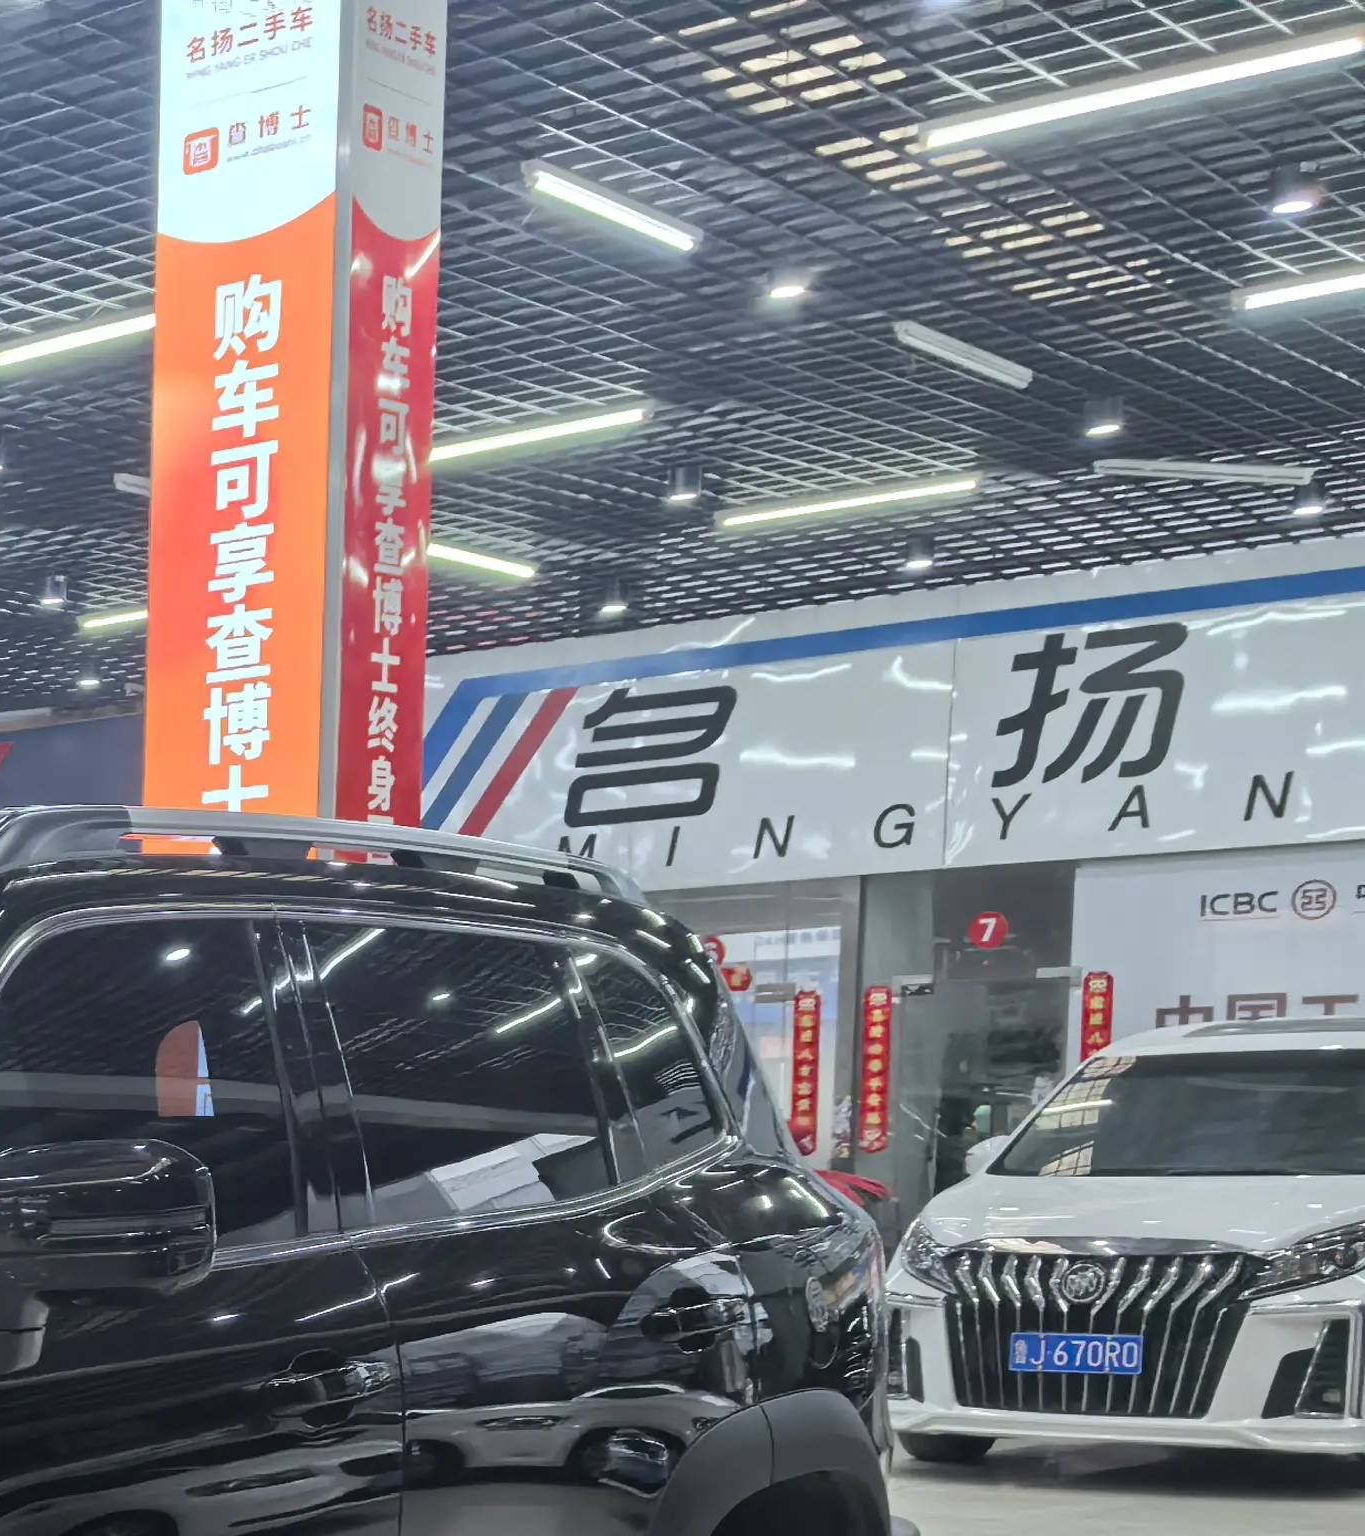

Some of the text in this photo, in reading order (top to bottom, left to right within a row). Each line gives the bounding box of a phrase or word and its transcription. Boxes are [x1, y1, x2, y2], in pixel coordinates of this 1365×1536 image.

[186, 6, 313, 63] 名扬二手车
[366, 6, 437, 56] 名扬二手车
[366, 275, 412, 824] 购车可享查博士终身
[1200, 891, 1279, 917] ICBC
[978, 917, 997, 942] 7
